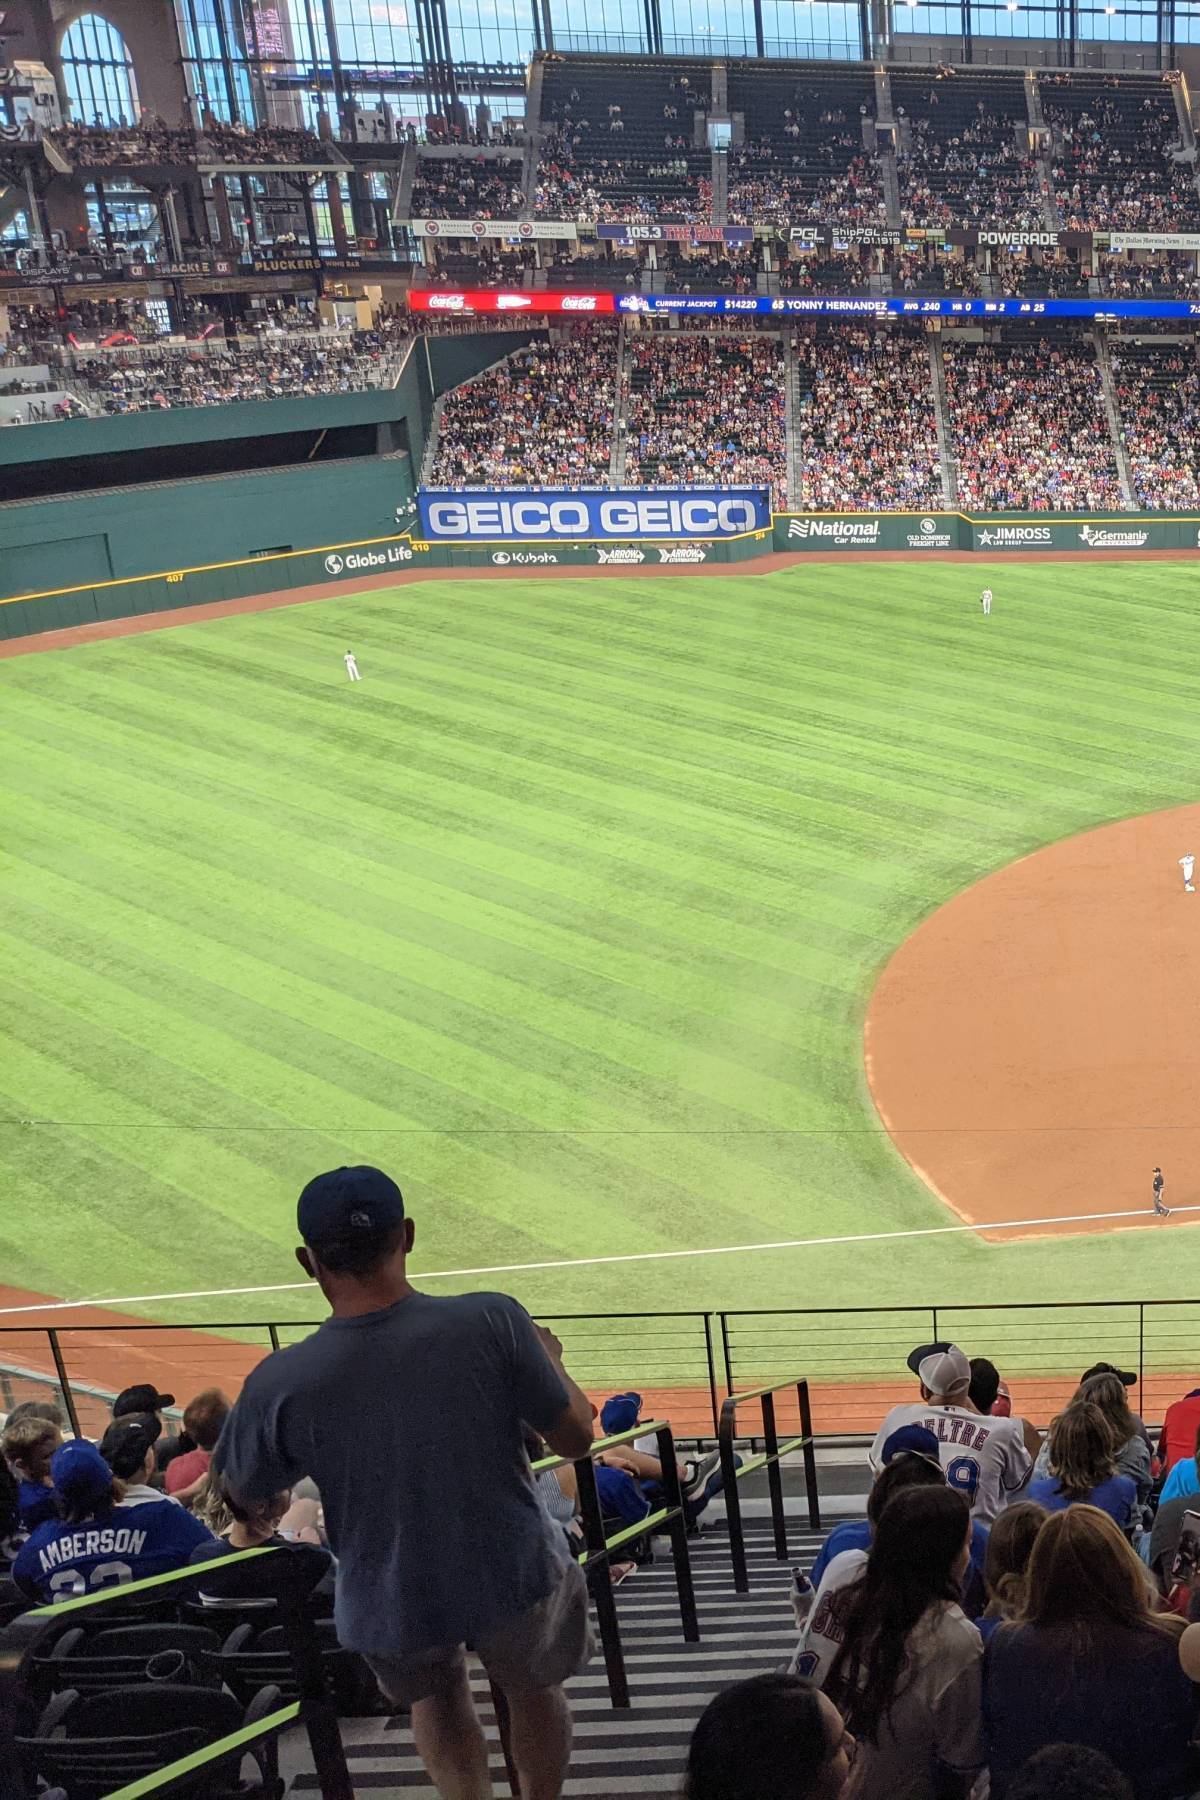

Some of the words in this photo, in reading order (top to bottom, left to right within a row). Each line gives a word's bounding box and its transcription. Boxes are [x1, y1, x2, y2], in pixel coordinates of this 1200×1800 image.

[626, 227, 661, 238] 105.3
[664, 227, 691, 239] THE
[694, 228, 724, 240] FAN
[790, 228, 825, 240] PGL
[832, 228, 900, 237] ShipPGL.com
[978, 232, 1058, 245] POWERADE
[255, 259, 321, 272] PLUCKERS
[146, 302, 168, 310] GRAND
[428, 296, 464, 309] Coca-Cola
[562, 296, 597, 310] Coca-Cola
[725, 300, 758, 308] $14220
[772, 301, 785, 310] 65
[787, 301, 824, 310] YONNY
[826, 302, 888, 310] HERNANDEZ
[921, 302, 940, 310] .240
[965, 303, 972, 311] 0
[1034, 304, 1044, 312] 25
[428, 501, 590, 534] GEICO
[600, 500, 756, 532] GEICO
[850, 536, 876, 544] Rental
[1098, 530, 1148, 540] Germania
[346, 552, 386, 569] Globe
[388, 546, 412, 562] Life
[512, 552, 558, 564] Kubota
[610, 550, 638, 558] ARROW
[671, 549, 699, 558] ARROW
[166, 574, 184, 583] 407
[38, 1528, 148, 1573] AMBERSON
